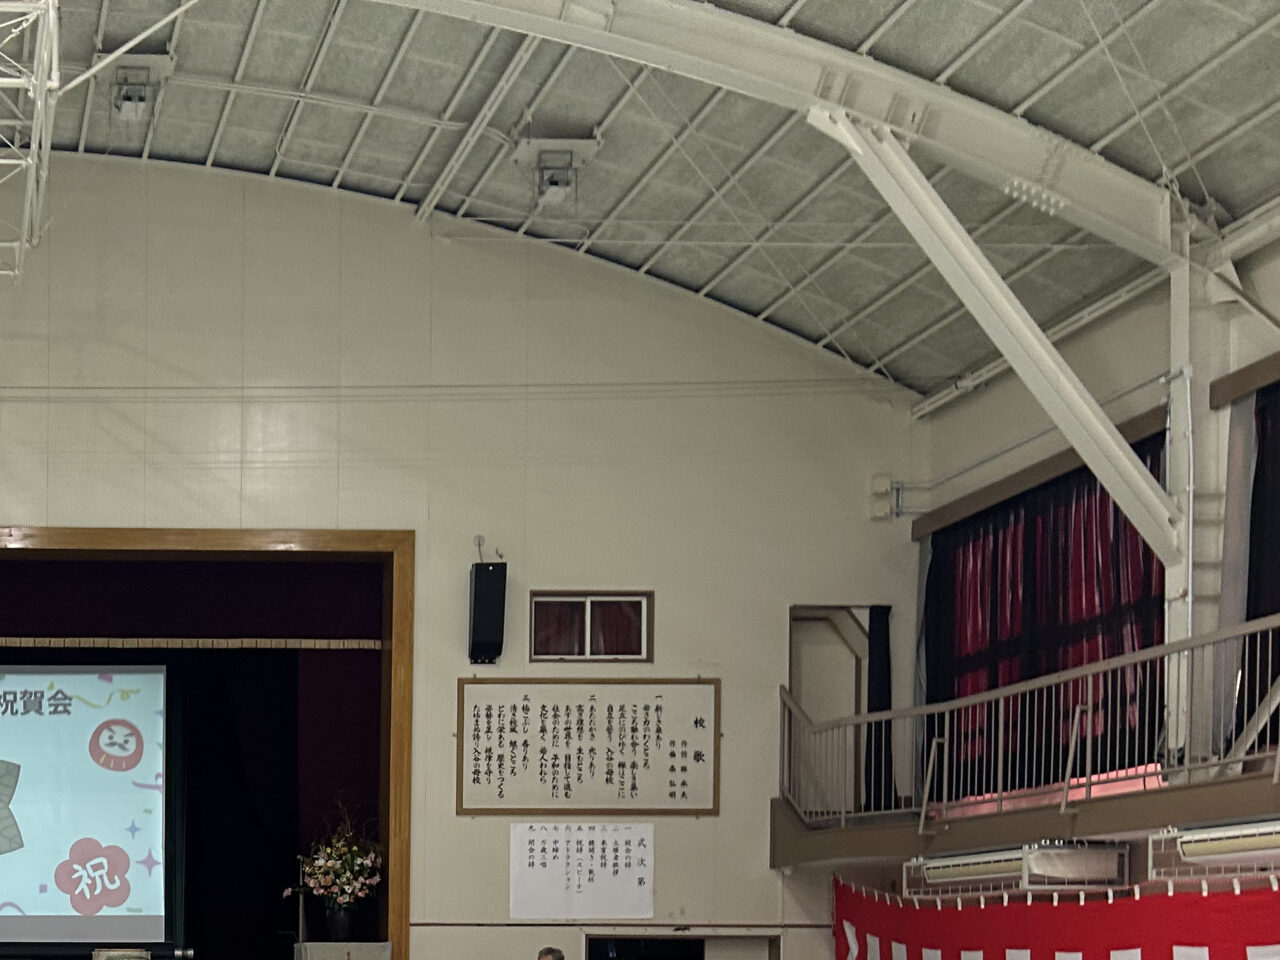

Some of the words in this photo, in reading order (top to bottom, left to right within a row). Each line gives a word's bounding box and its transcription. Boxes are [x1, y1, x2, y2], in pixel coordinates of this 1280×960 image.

[693, 716, 706, 763] 校歌
[552, 754, 560, 798] 平和のために
[72, 855, 120, 900] 祝
[636, 838, 646, 886] 式次第
